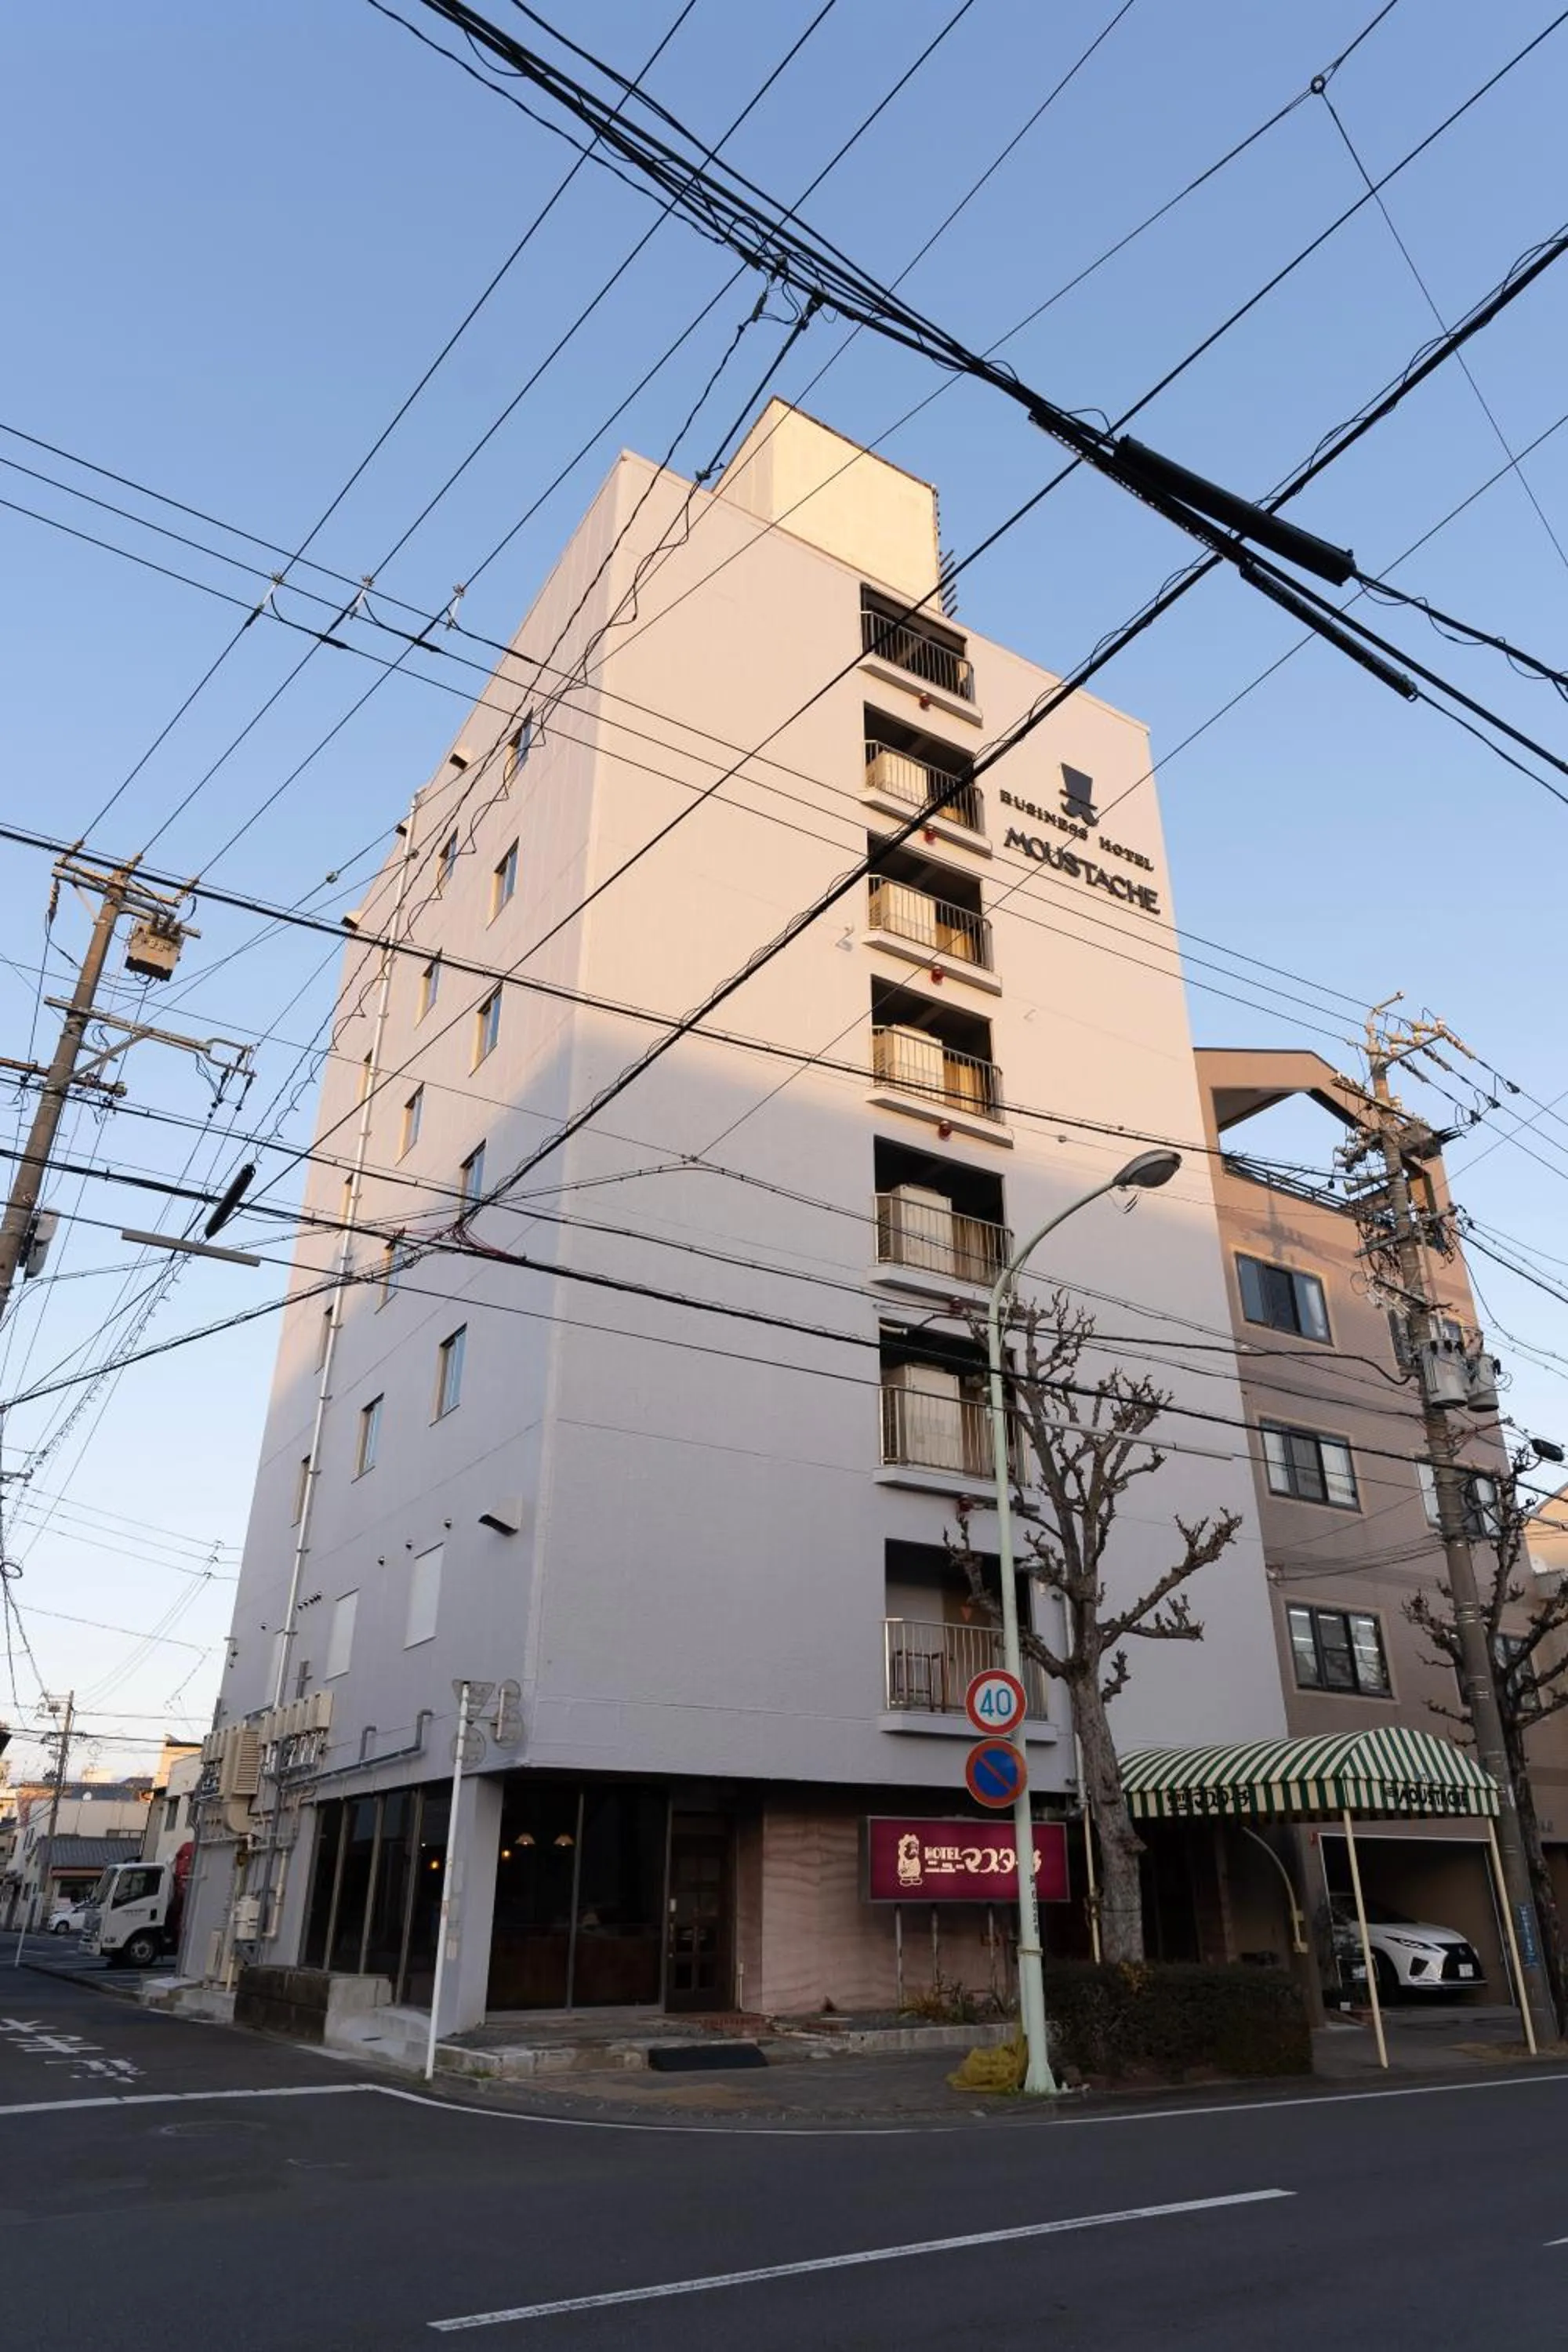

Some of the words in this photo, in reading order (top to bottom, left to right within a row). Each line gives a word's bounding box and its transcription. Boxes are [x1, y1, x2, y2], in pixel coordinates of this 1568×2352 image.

[1000, 789, 1089, 840] BUSINESS
[1098, 836, 1154, 872] HOTEL
[1004, 827, 1161, 915] MOUSTACHE
[980, 1688, 1013, 1717] 40
[924, 1846, 963, 1860] HOTEL
